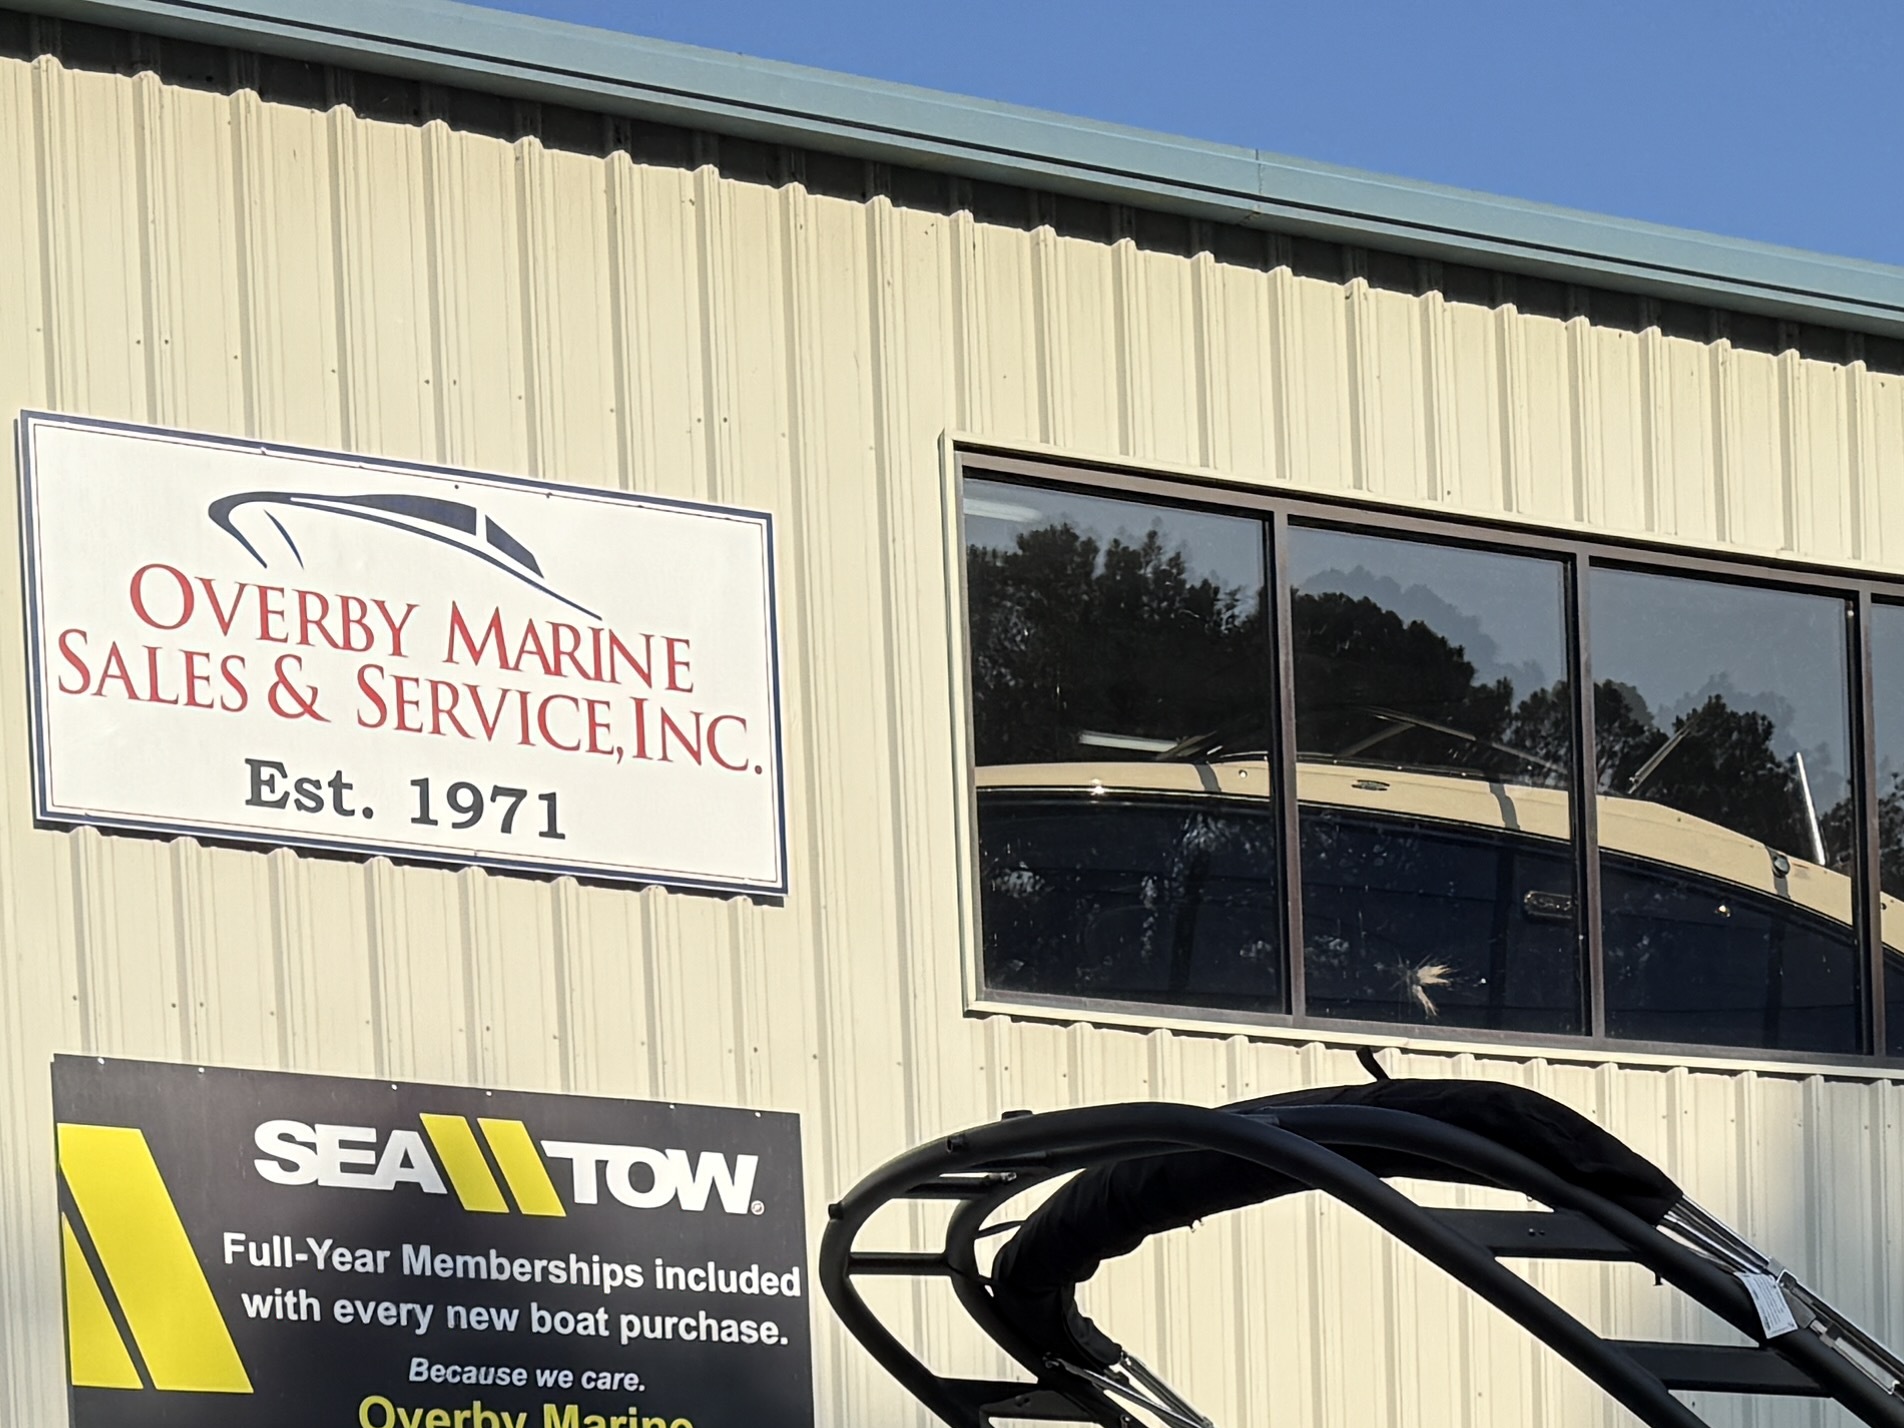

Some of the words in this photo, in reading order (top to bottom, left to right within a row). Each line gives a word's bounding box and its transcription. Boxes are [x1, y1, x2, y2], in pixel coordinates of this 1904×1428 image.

[129, 563, 420, 659] OVERBY
[445, 600, 695, 693] MARINE
[57, 629, 250, 713] SALES
[267, 653, 331, 724] &
[244, 758, 374, 820] Est.
[409, 777, 567, 840] 1971
[253, 1119, 448, 1195] SEA
[222, 1231, 391, 1276] Full-Year
[402, 1243, 645, 1294] Memberships
[654, 1257, 802, 1298] included
[241, 1288, 322, 1323] with
[333, 1298, 434, 1337] every
[446, 1303, 520, 1332] new
[531, 1304, 610, 1337] boat
[619, 1310, 790, 1347] purchase.
[408, 1356, 527, 1387] Because
[534, 1367, 574, 1390] we
[579, 1368, 647, 1393] care.
